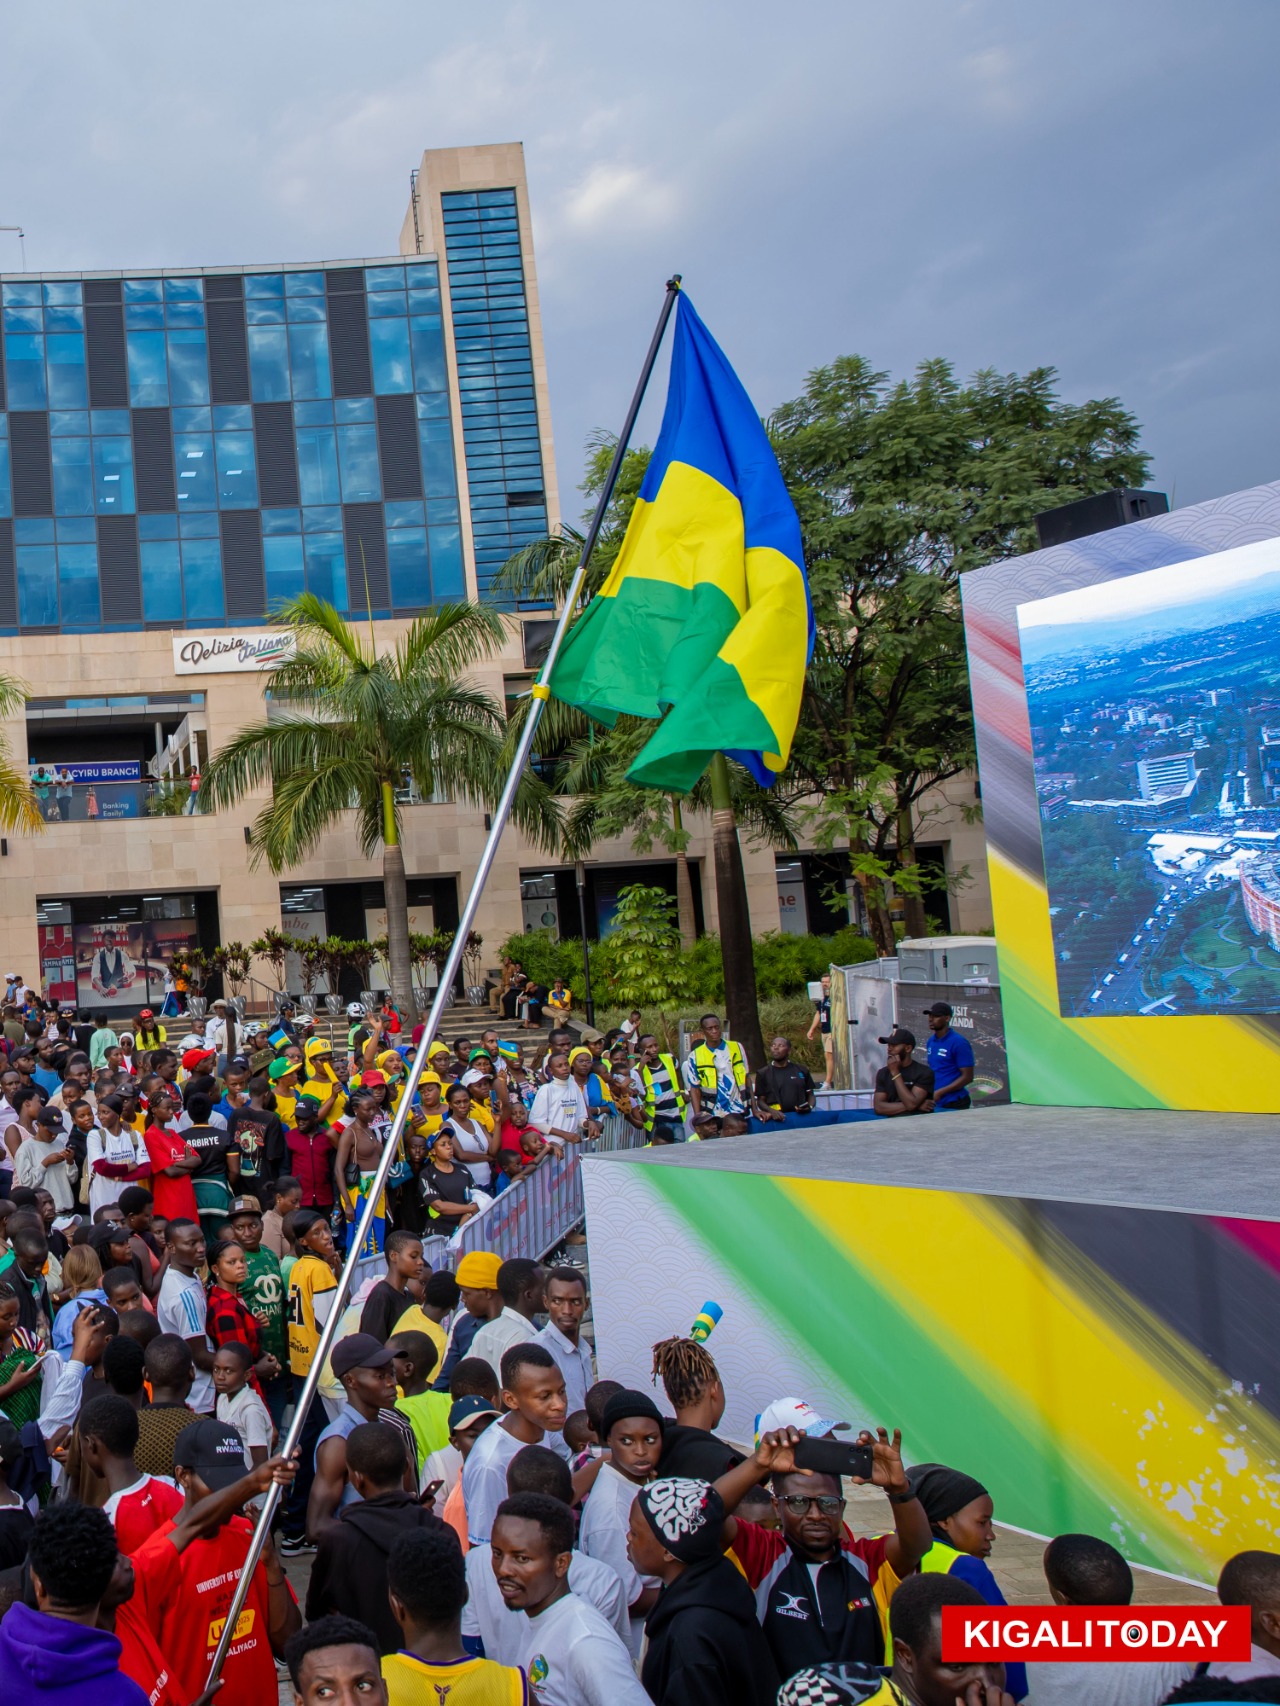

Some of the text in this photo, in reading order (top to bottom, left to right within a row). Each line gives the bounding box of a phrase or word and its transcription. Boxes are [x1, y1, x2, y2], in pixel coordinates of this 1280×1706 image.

[180, 638, 245, 665] Delizia
[66, 768, 100, 778] ACYIRU
[101, 767, 139, 777] BRANCH
[102, 802, 130, 810] Banking
[282, 916, 310, 930] mba
[376, 912, 417, 926] sia
[949, 1017, 974, 1029] ANDA
[196, 1573, 227, 1594] UNIVERSITY
[226, 1571, 234, 1582] OF
[775, 1607, 808, 1620] GILBERT
